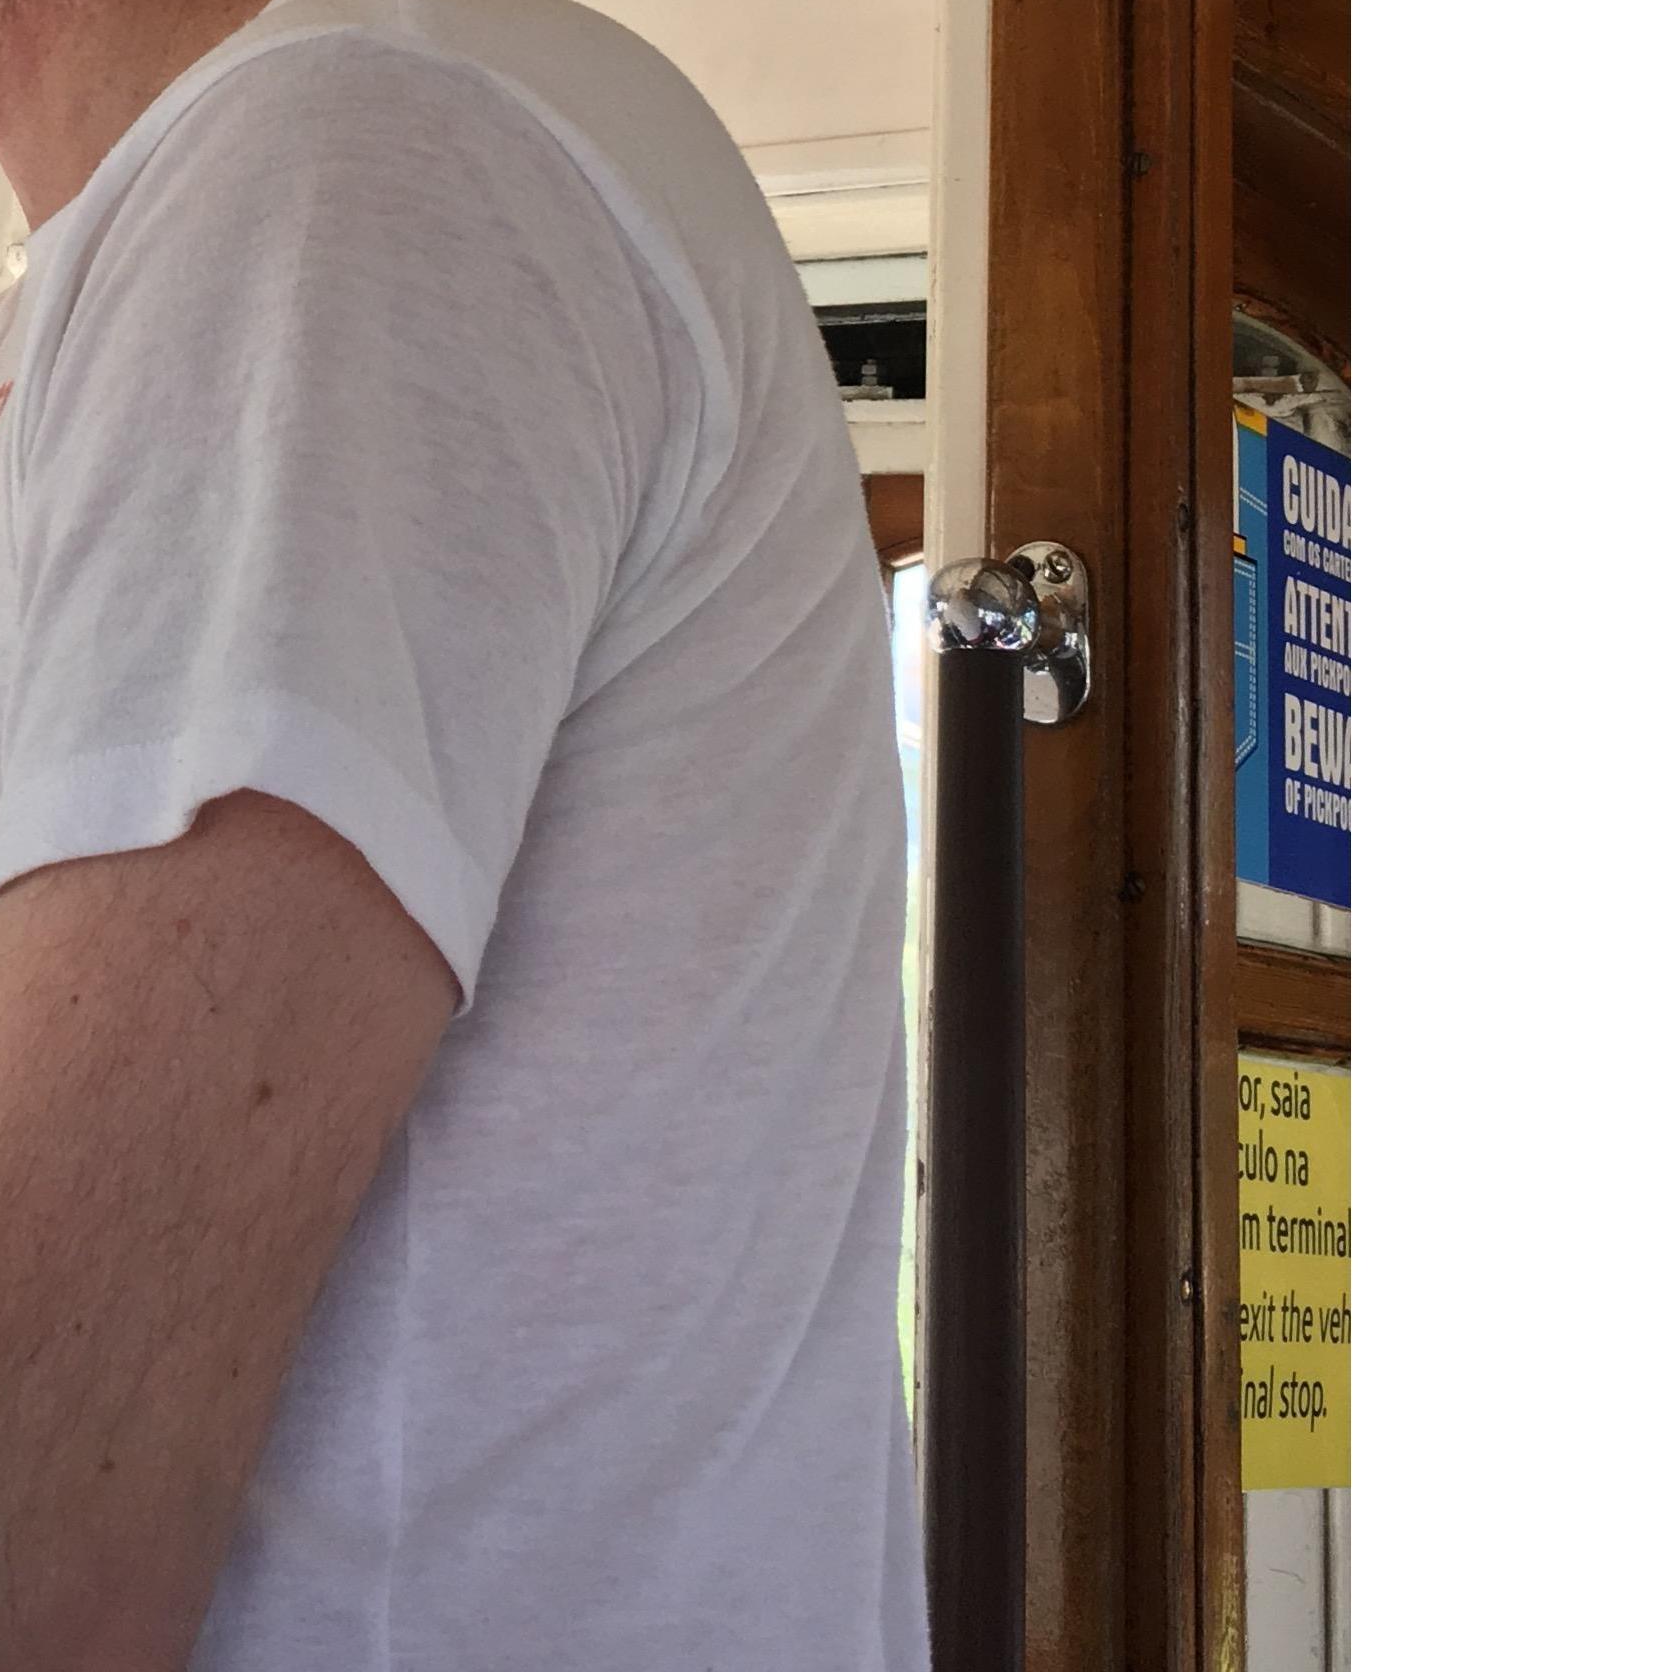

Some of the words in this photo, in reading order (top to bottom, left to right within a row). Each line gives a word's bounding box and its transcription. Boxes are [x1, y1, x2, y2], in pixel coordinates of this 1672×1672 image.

[1284, 529, 1307, 563] COM
[1307, 540, 1321, 569] OS
[1284, 641, 1308, 681] AUX
[1285, 777, 1301, 815] OF
[1270, 1071, 1311, 1121] saia
[1284, 1148, 1309, 1187] na
[1239, 1290, 1276, 1343] exit
[1281, 1289, 1313, 1343] the
[1279, 1371, 1327, 1433] stop.
